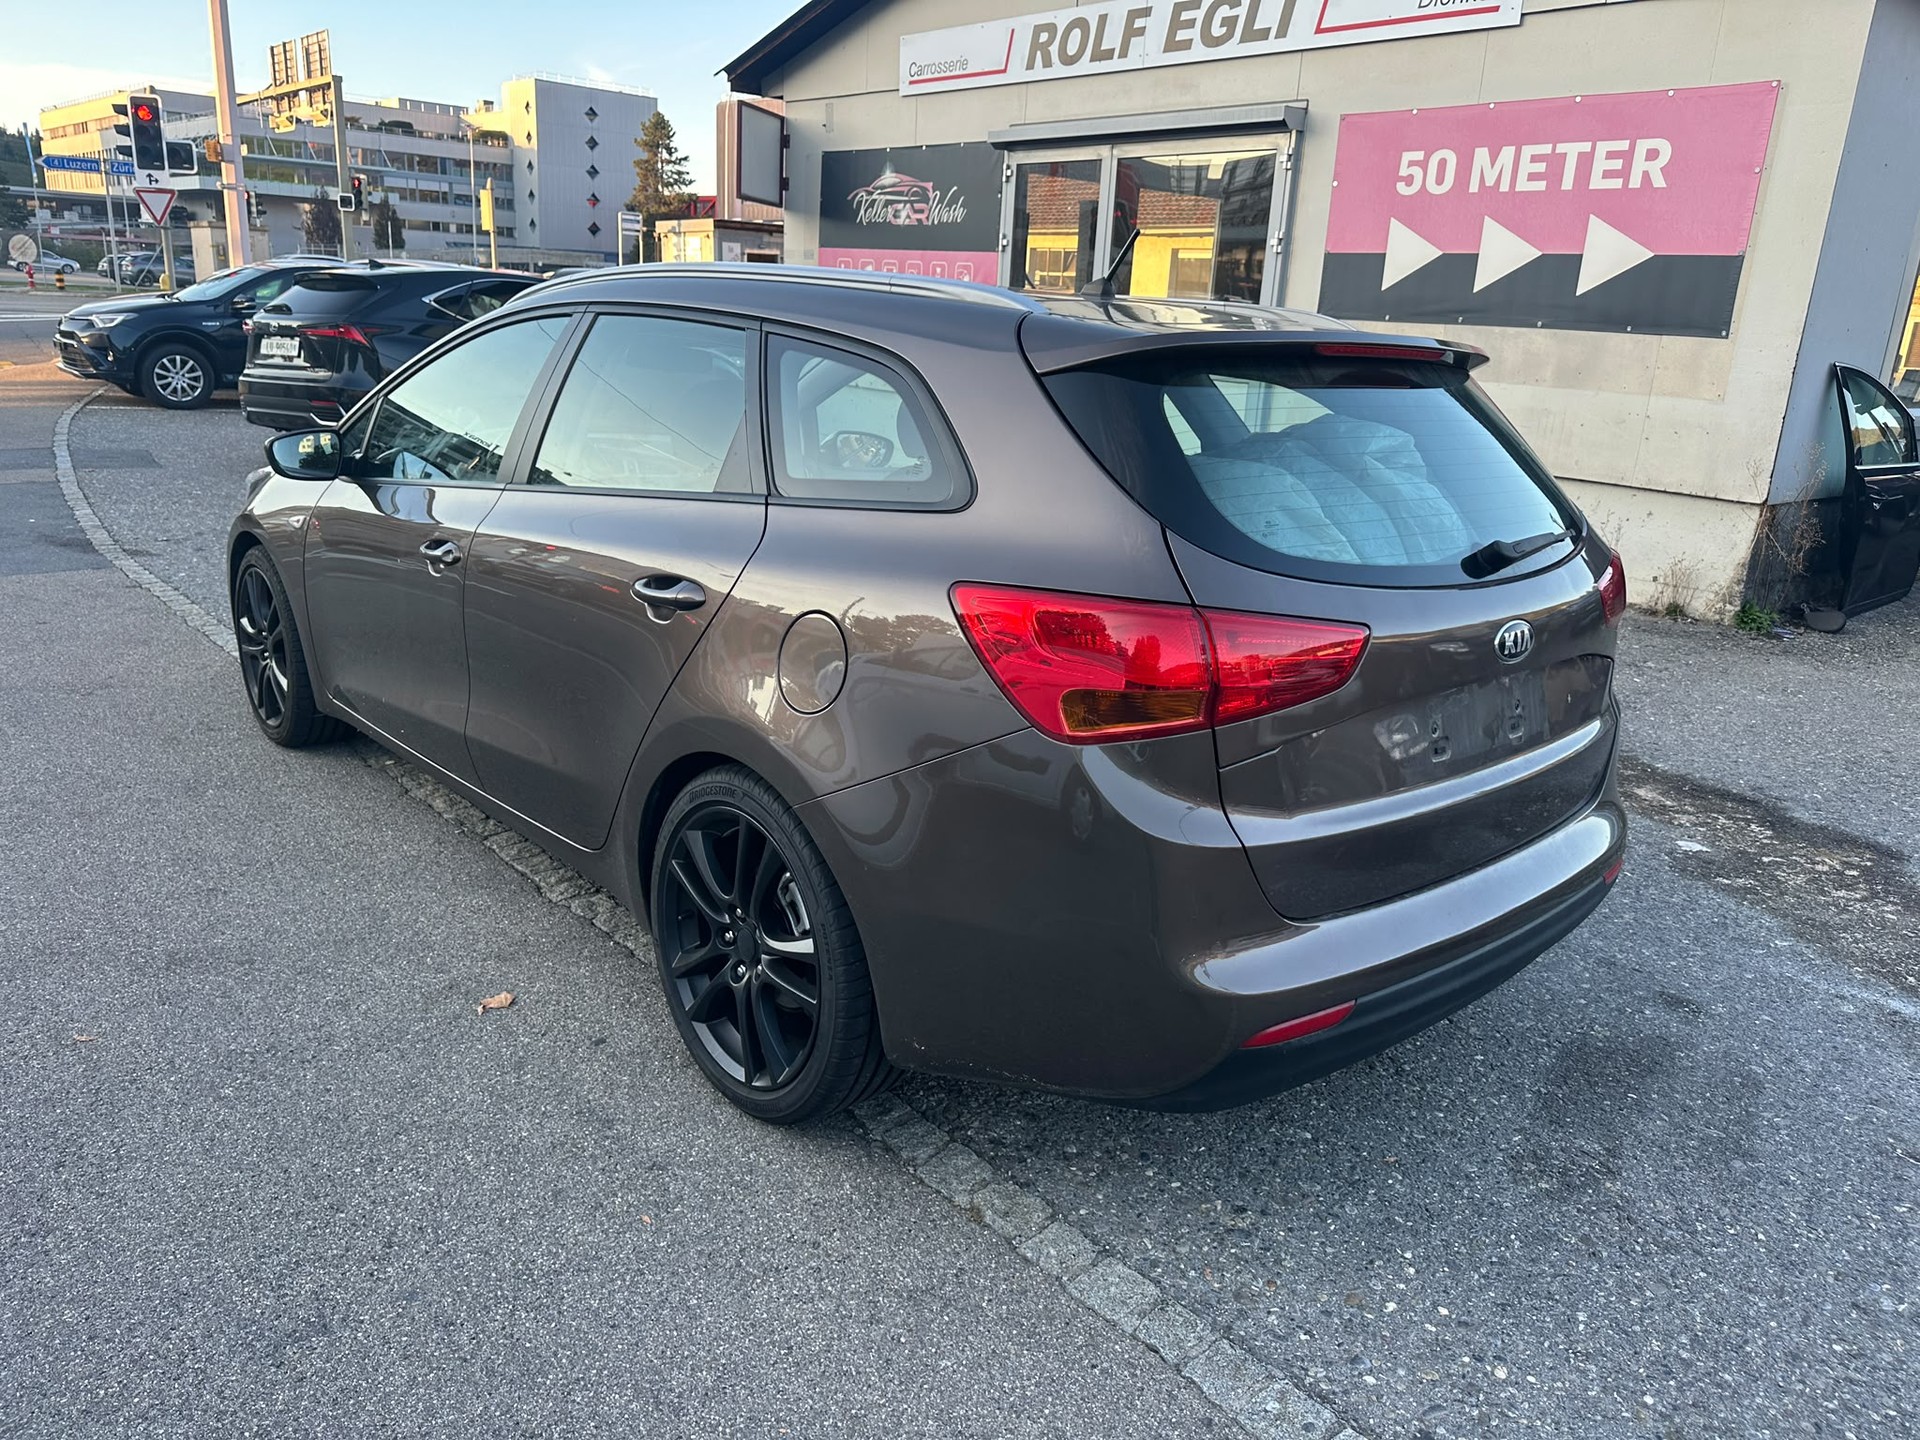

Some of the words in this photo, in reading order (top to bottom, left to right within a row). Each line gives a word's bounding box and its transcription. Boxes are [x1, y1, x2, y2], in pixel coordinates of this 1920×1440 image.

[1025, 5, 1153, 71] ROLF
[1163, 0, 1297, 53] EGLI
[908, 55, 969, 79] Carrosserie
[63, 159, 98, 171] Luzern
[112, 162, 135, 173] Züri
[1395, 148, 1458, 196] 50
[1468, 138, 1673, 193] METER
[853, 189, 895, 226] Keller
[890, 203, 929, 225] CAR
[928, 186, 967, 226] Wash
[1503, 627, 1531, 655] KIA
[688, 785, 738, 804] BRIDGESTONE
